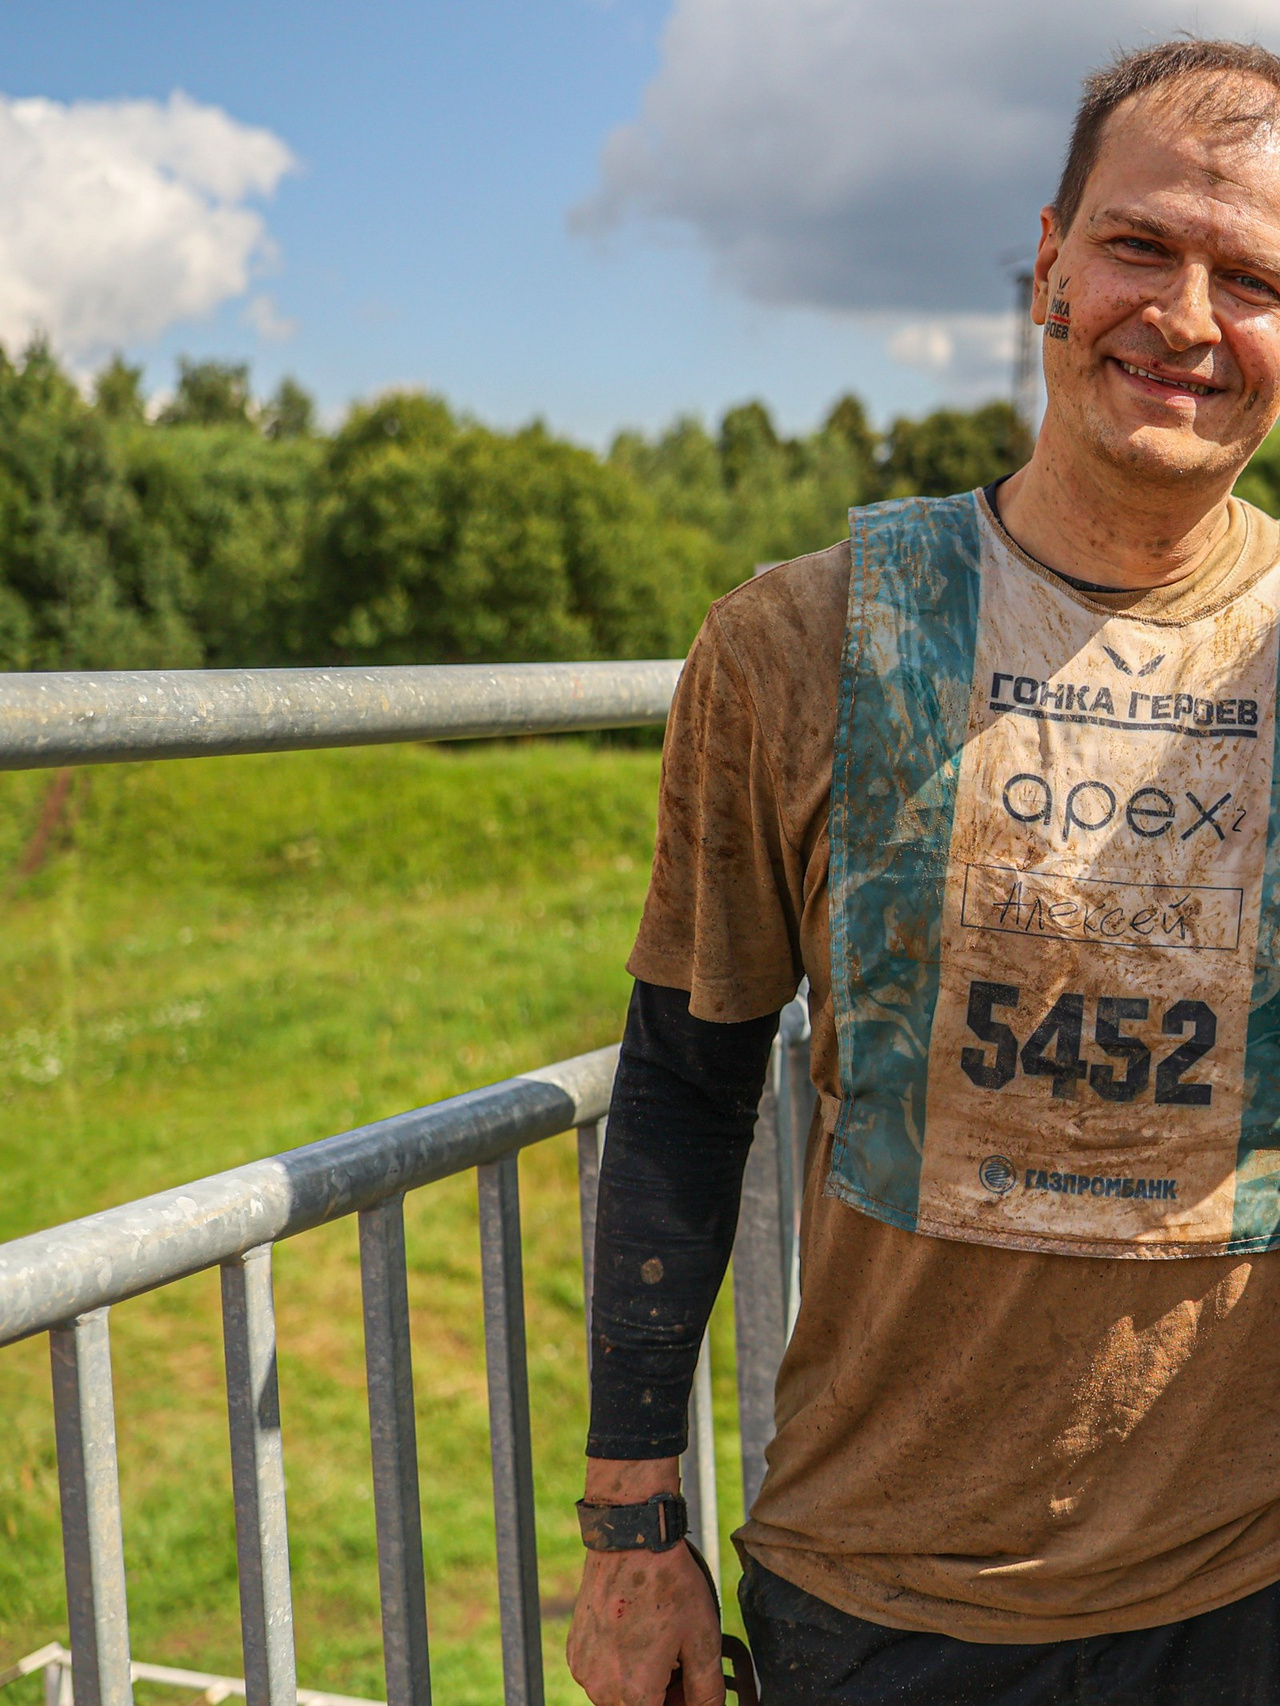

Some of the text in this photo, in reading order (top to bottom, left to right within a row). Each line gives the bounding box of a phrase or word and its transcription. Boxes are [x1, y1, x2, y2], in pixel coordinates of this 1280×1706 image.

[990, 671, 1259, 726] ГОНКА ГЕРОЕВ
[1002, 772, 1232, 843] apex
[993, 881, 1191, 942] Алексей
[960, 980, 1217, 1105] 5452
[1024, 1168, 1178, 1200] ГАЗПРОМБАНК
